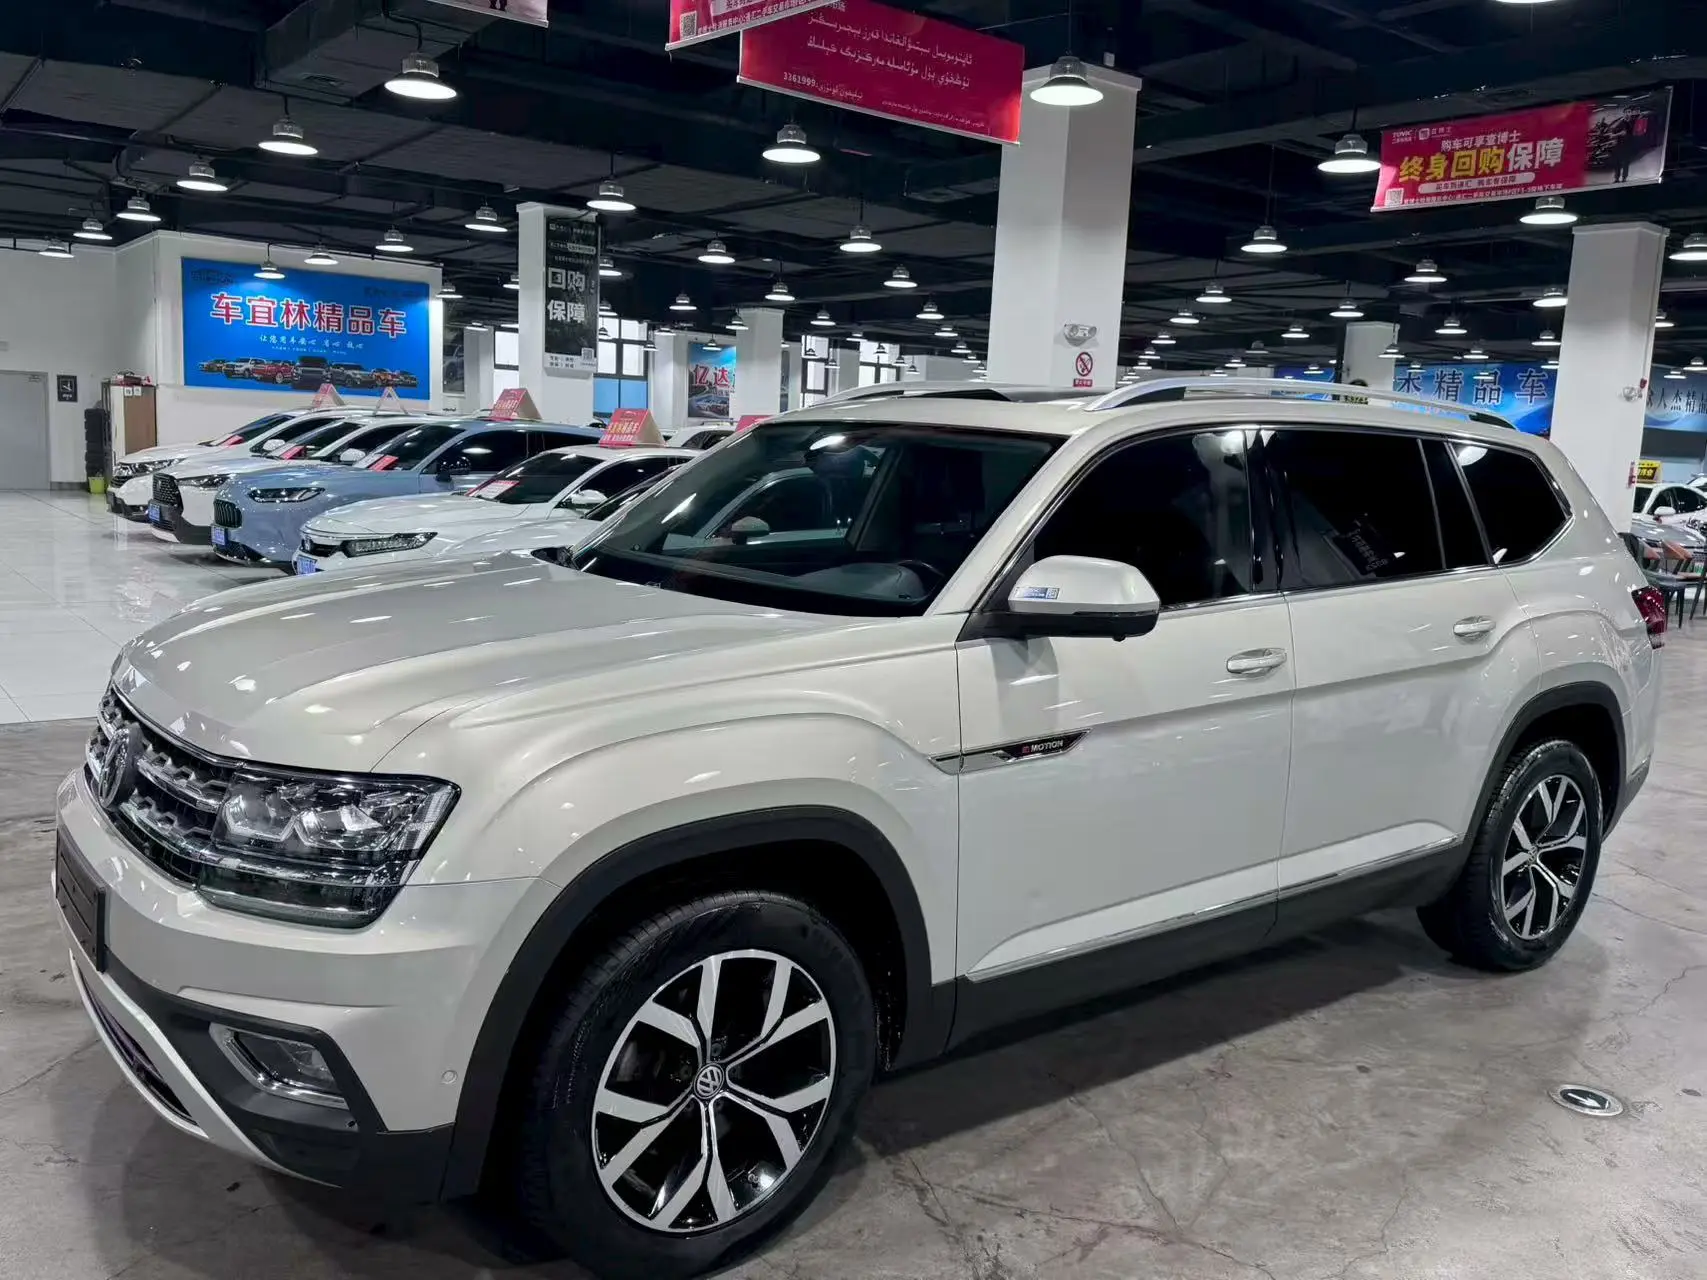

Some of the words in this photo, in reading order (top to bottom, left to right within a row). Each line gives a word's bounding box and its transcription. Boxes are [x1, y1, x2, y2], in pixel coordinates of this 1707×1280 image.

[1399, 138, 1565, 182] 终身回购保障
[210, 291, 407, 339] 车宜林精品车
[547, 299, 586, 323] 保障
